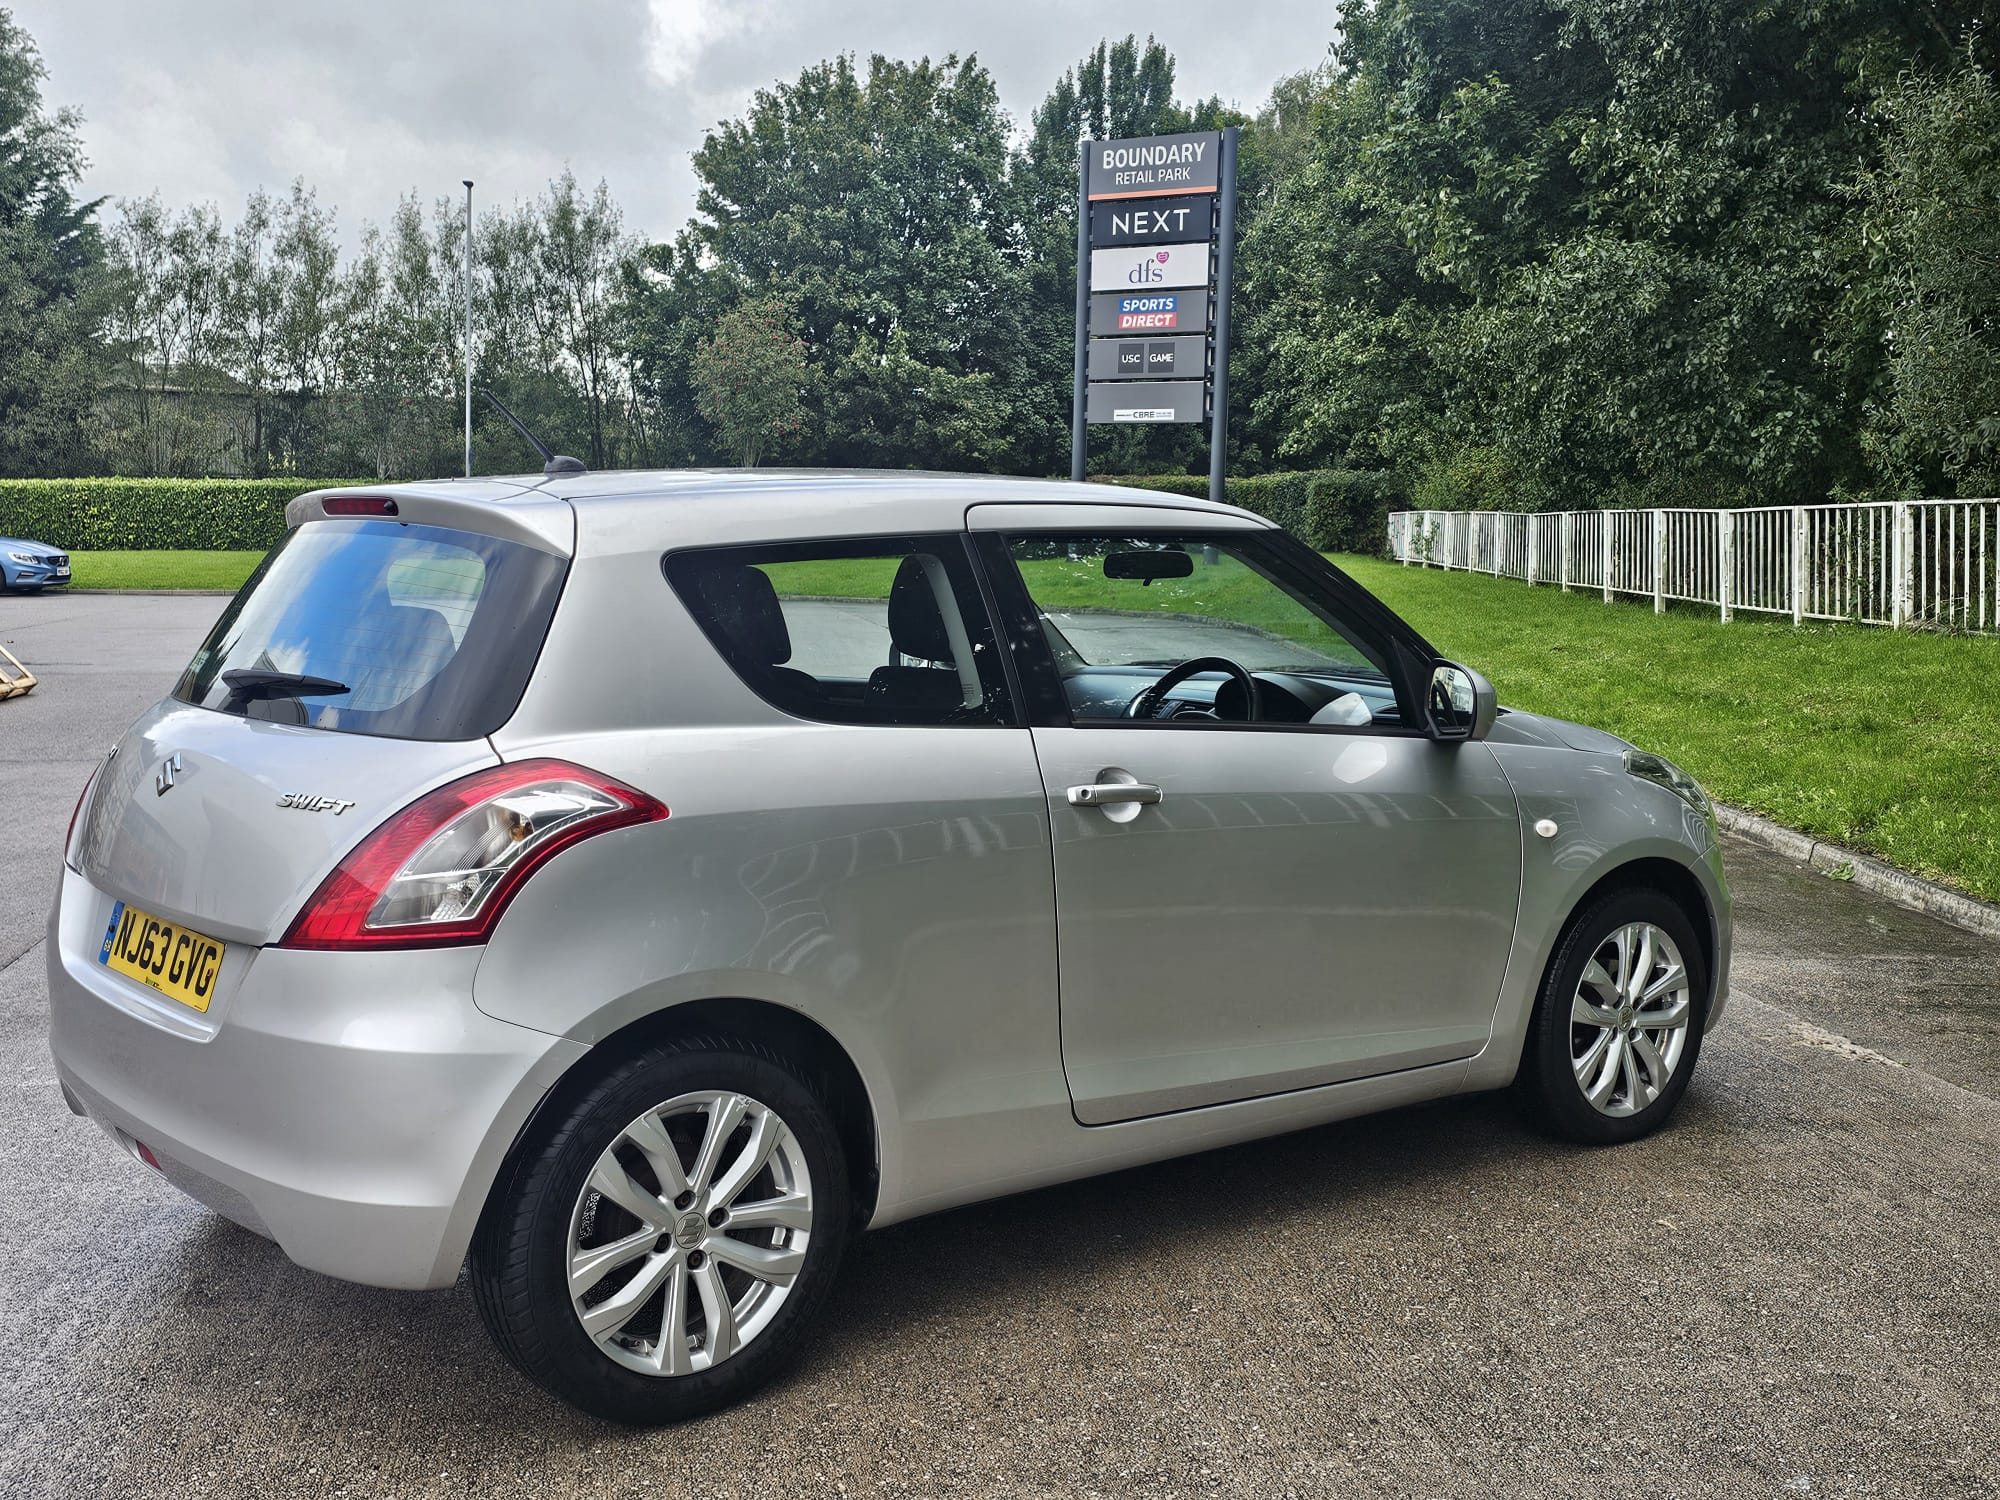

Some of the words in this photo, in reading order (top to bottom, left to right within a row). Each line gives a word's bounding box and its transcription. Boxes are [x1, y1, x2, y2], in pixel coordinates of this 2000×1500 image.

[1103, 142, 1206, 169] BOUNDARY
[1115, 170, 1155, 185] RETAIL
[1158, 167, 1191, 181] PARK
[1111, 208, 1191, 235] NEXT
[1128, 258, 1163, 284] dfs
[1122, 298, 1174, 312] SPORTS
[1122, 314, 1173, 327] DIRECT
[1121, 354, 1141, 363] USC
[1149, 353, 1174, 363] GAME
[275, 792, 356, 816] SWIFT
[113, 910, 173, 976] NJ63
[168, 934, 217, 997] GVG
